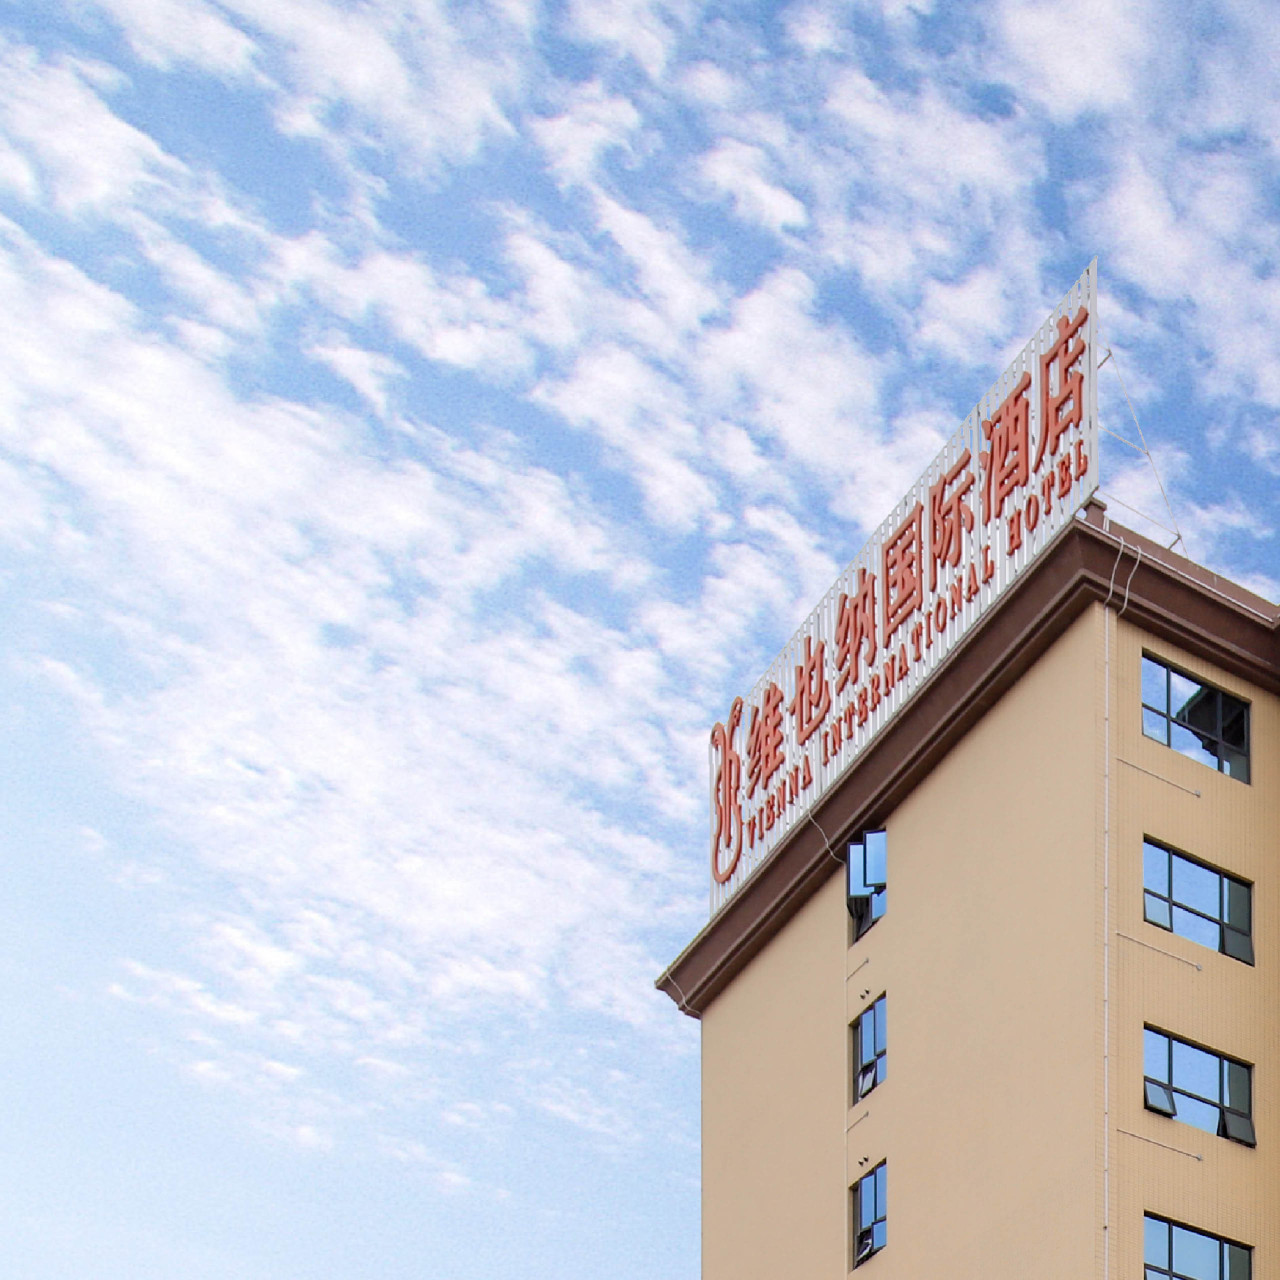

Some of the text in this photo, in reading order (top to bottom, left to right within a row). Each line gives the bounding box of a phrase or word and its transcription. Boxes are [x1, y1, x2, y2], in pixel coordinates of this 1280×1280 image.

[745, 438, 1089, 849] VIENNA INTERNATIONAL HOTEL
[746, 307, 1089, 799] 维也纳国际酒店
